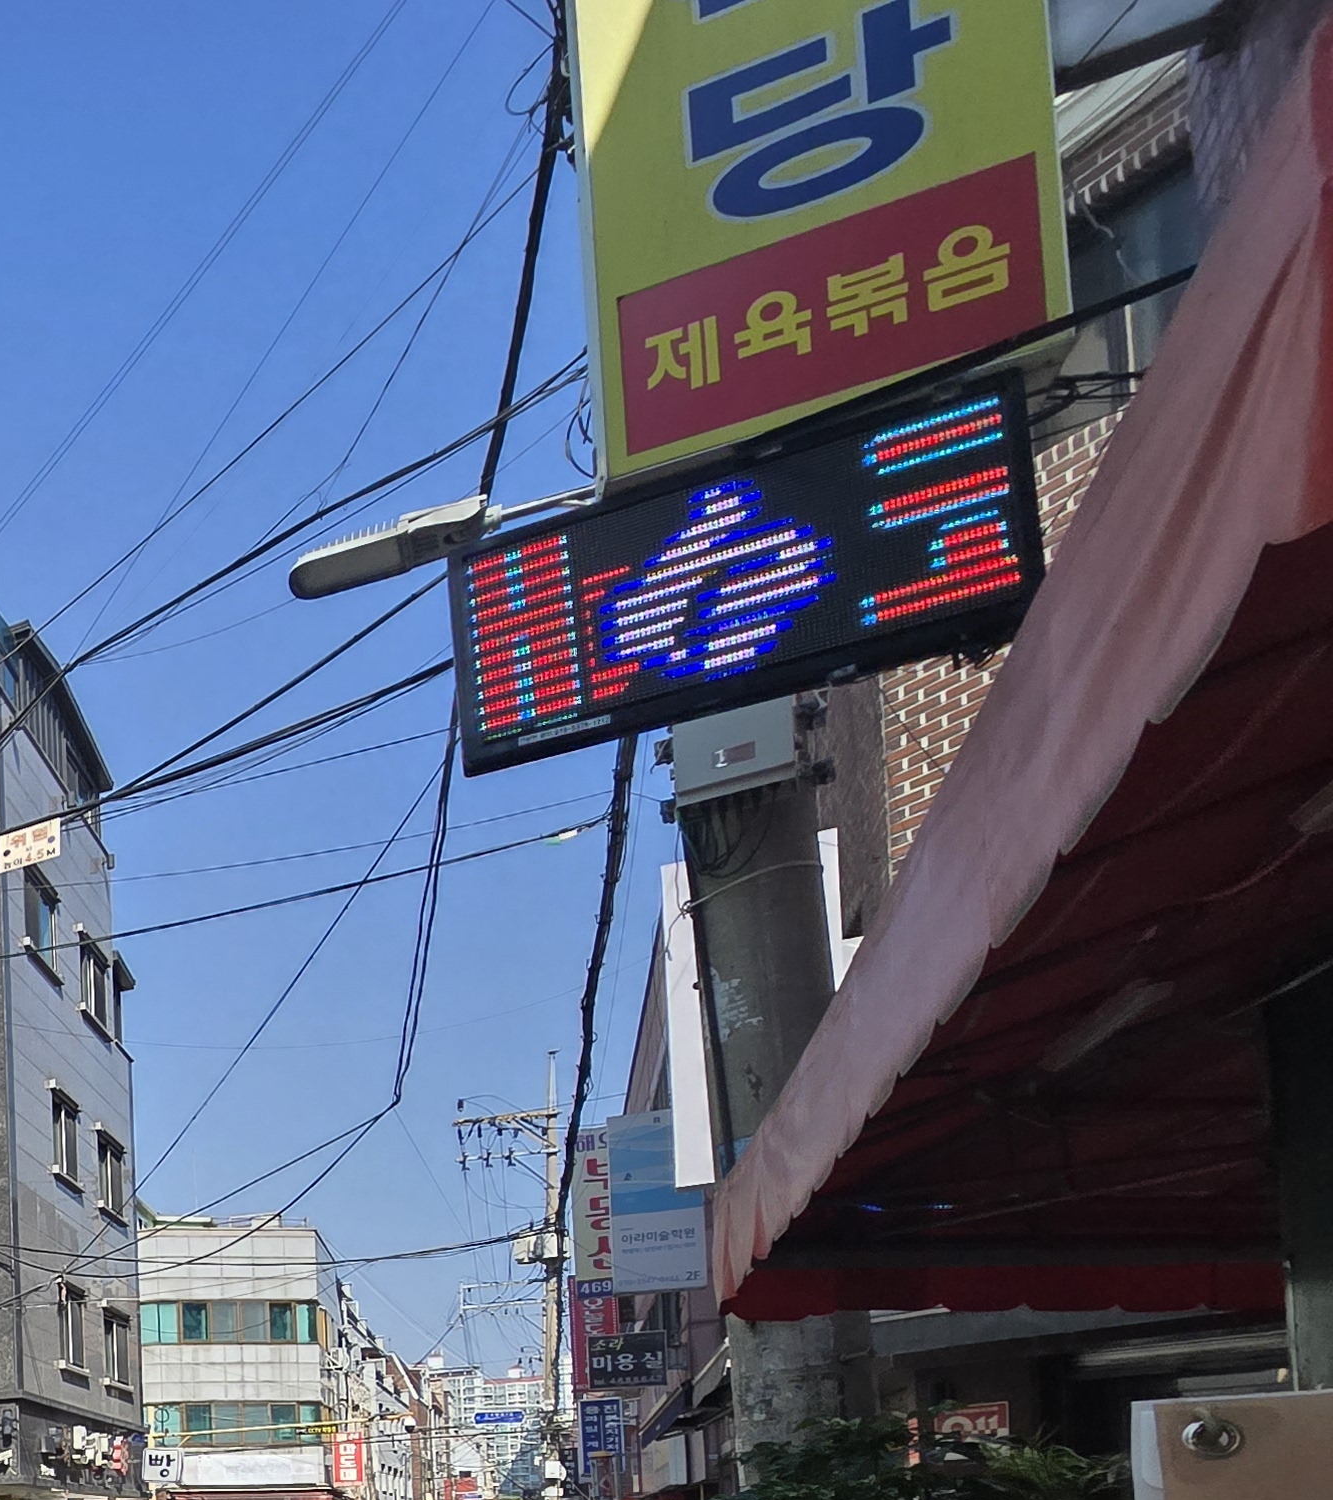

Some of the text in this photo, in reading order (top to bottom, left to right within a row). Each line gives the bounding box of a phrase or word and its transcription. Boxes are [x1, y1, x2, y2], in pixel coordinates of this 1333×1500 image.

[688, 0, 951, 218] 당
[645, 224, 1011, 391] 제육볶음
[621, 1227, 695, 1244] 아라미술학원
[685, 1271, 701, 1282] 2F
[591, 1351, 664, 1372] 미용실
[148, 1453, 176, 1478] 빵
